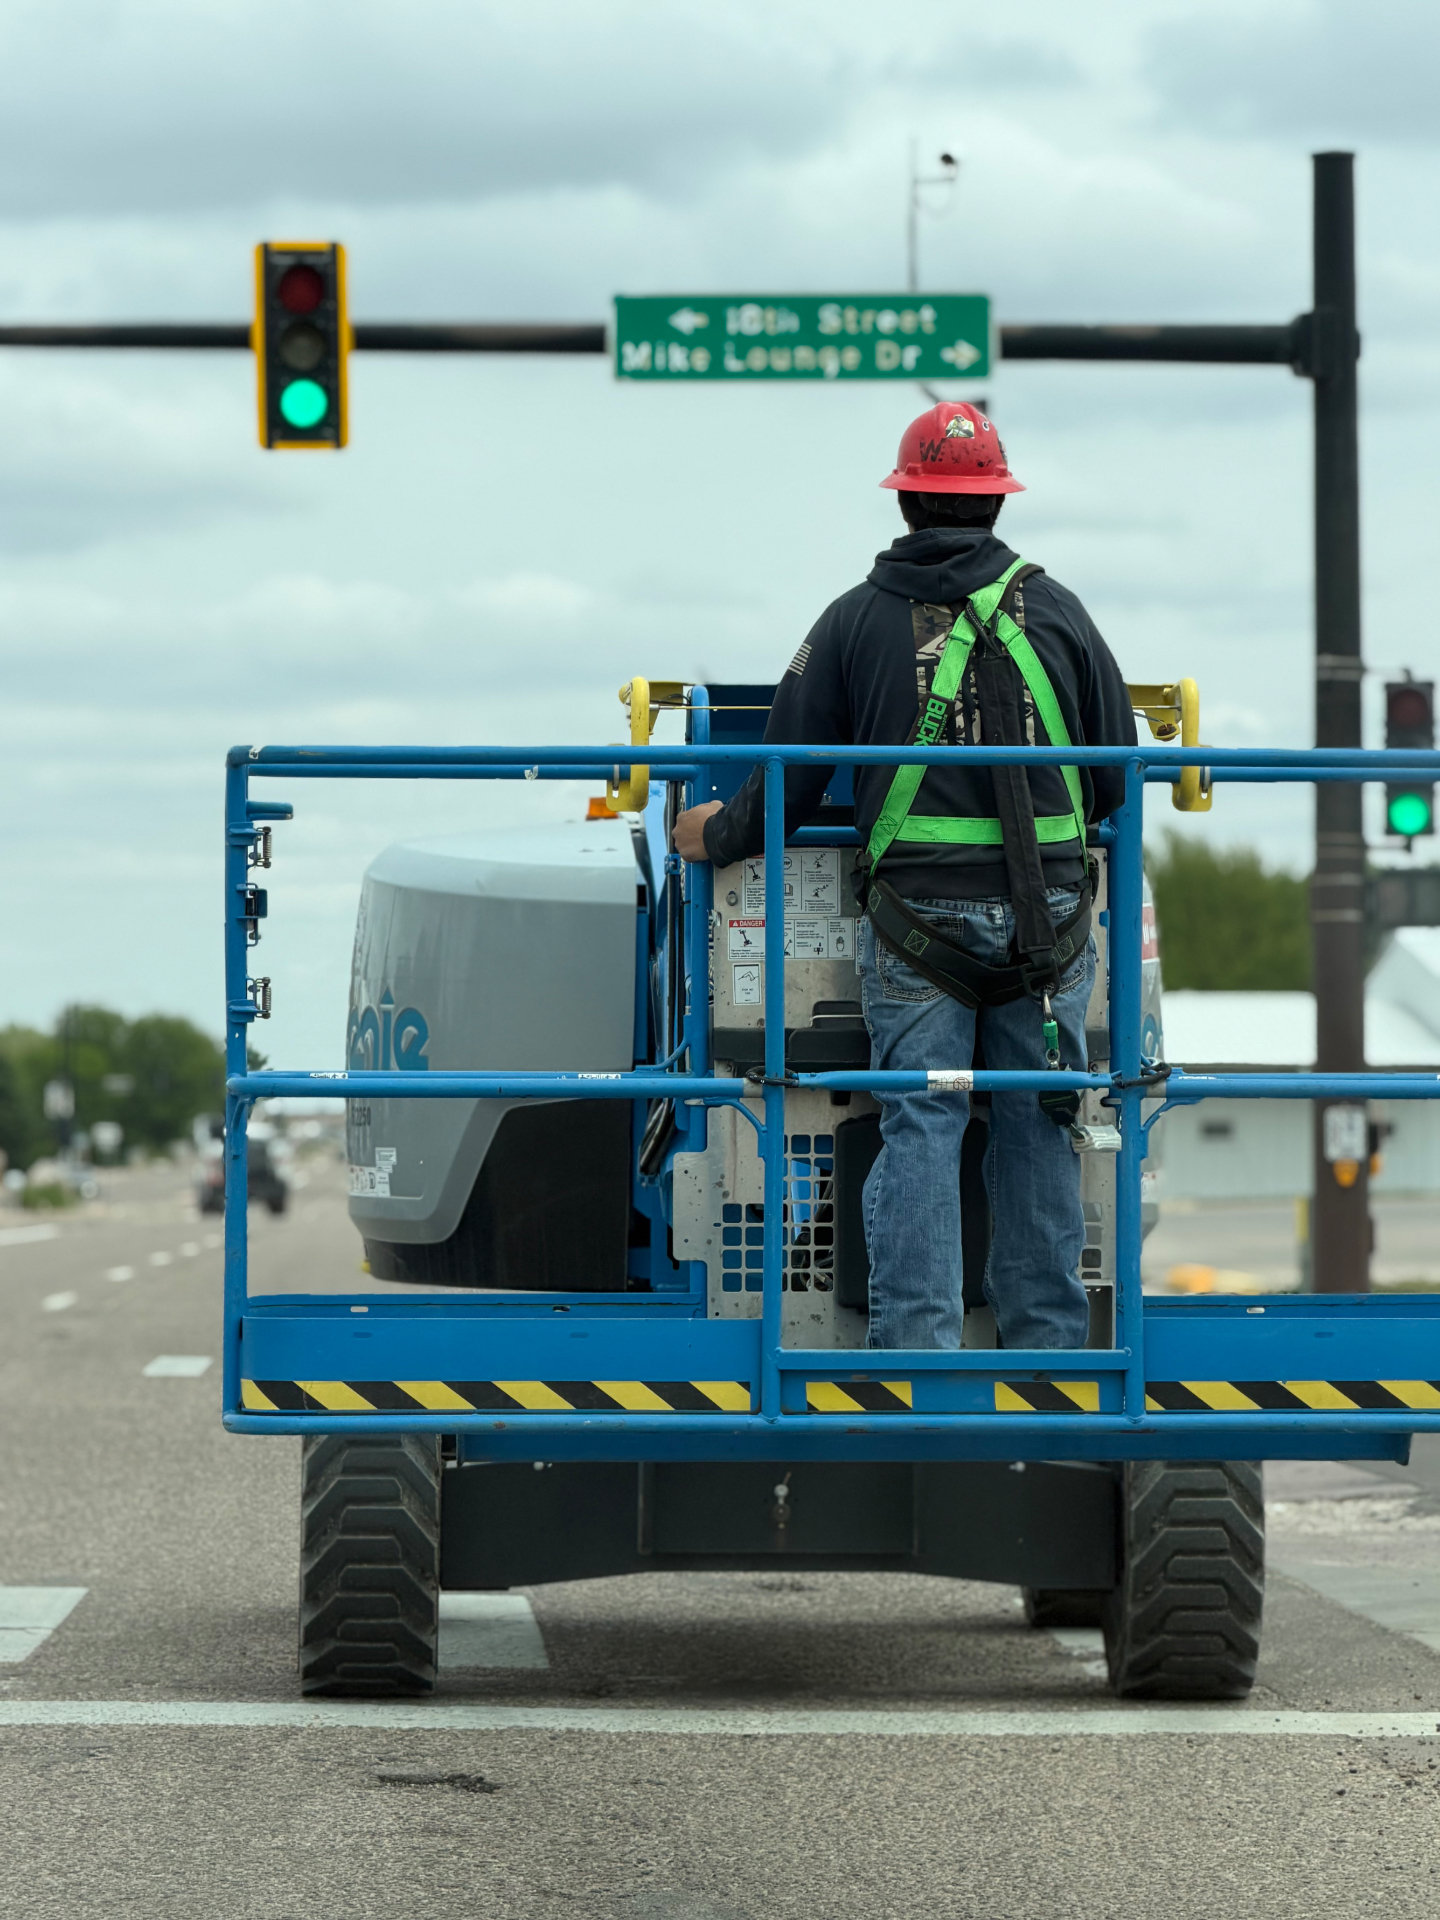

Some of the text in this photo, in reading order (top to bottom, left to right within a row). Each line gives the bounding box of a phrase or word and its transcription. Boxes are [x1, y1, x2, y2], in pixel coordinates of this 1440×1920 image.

[817, 303, 937, 336] Street
[621, 339, 923, 379] Mike Lounge Dr
[913, 697, 947, 746] BUCK
